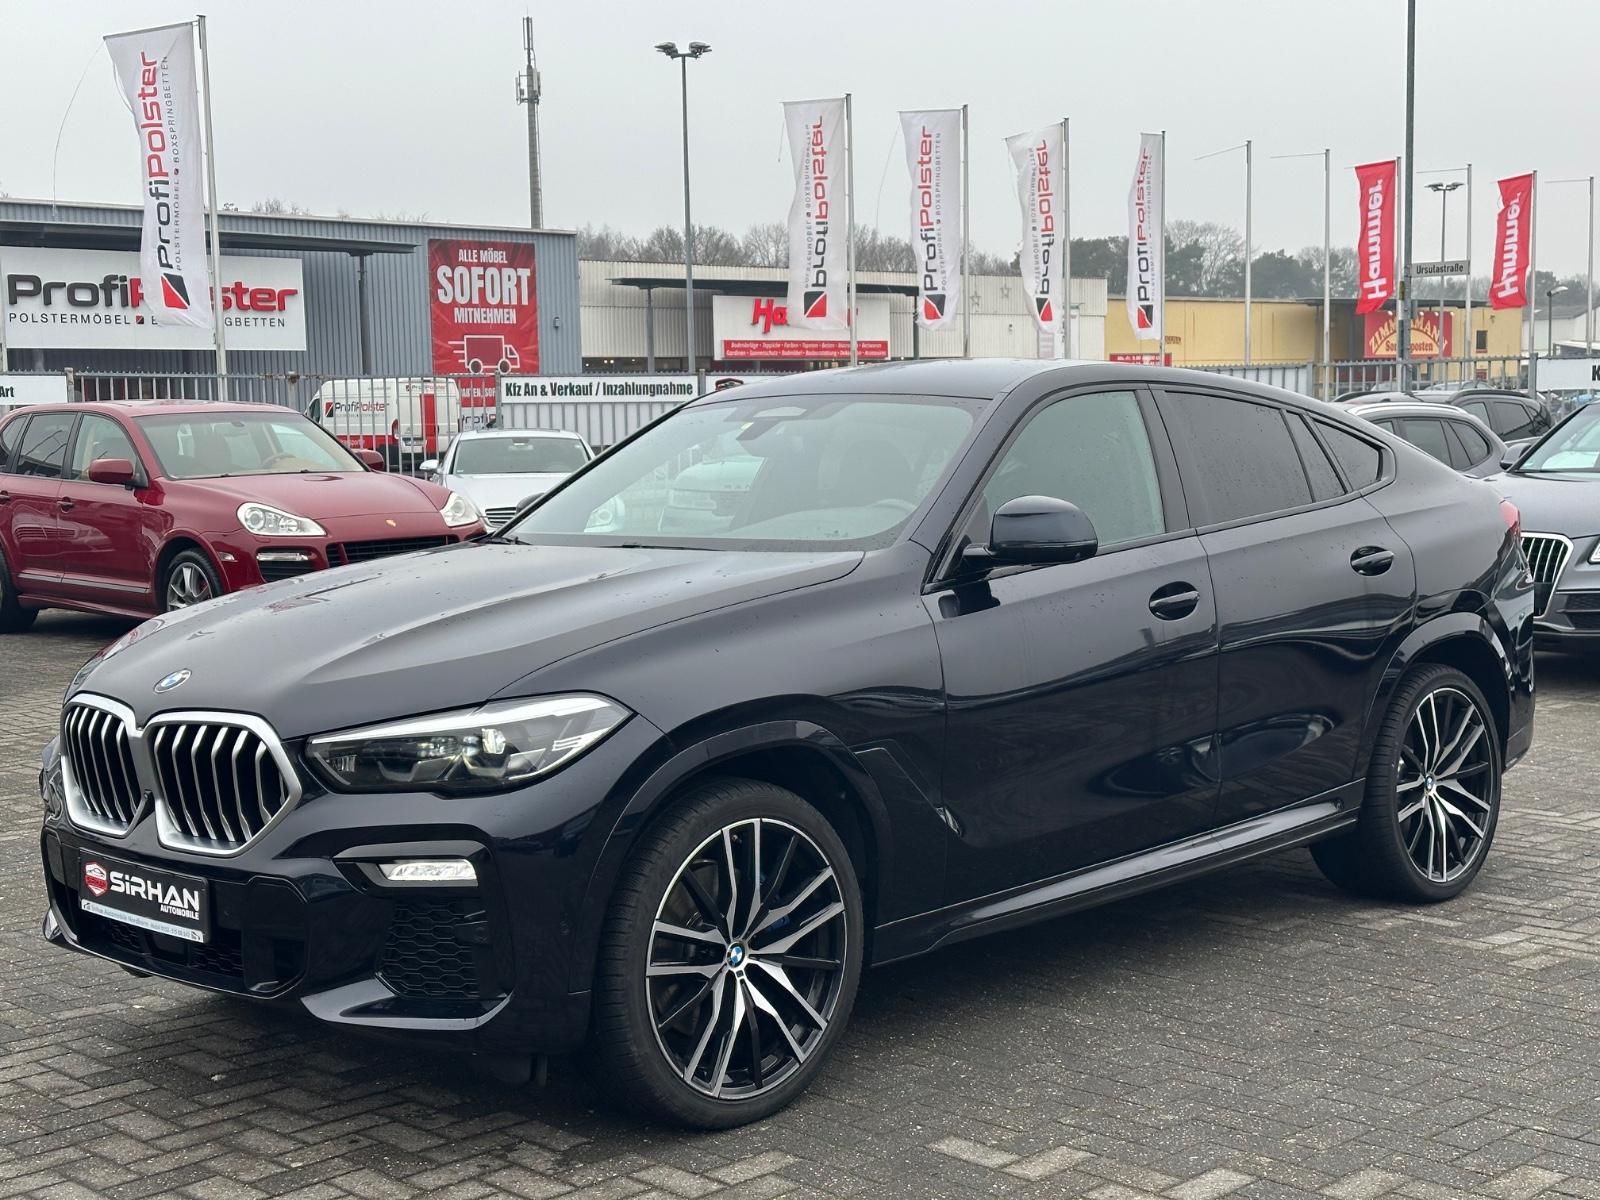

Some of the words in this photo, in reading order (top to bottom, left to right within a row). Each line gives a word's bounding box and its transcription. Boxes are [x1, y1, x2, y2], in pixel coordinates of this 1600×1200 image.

[162, 56, 180, 164] BOXSPRINGBETTEN
[138, 51, 173, 268] ProfiPolster
[917, 126, 938, 292] ProfiPolster
[458, 249, 478, 262] ALLE
[480, 248, 508, 264] MÖBEL
[1416, 263, 1464, 275] Ursulastraße
[436, 265, 531, 306] SOFORT
[9, 313, 130, 325] POLSTERMÖBEL
[454, 307, 517, 324] MITNEHMEN
[505, 382, 522, 397] Kfz
[524, 382, 538, 396] An
[540, 384, 548, 396] &
[550, 381, 593, 397] Verkauf
[602, 381, 693, 398] Inzahlungnahme
[160, 904, 200, 921] AUTOMOBILE
